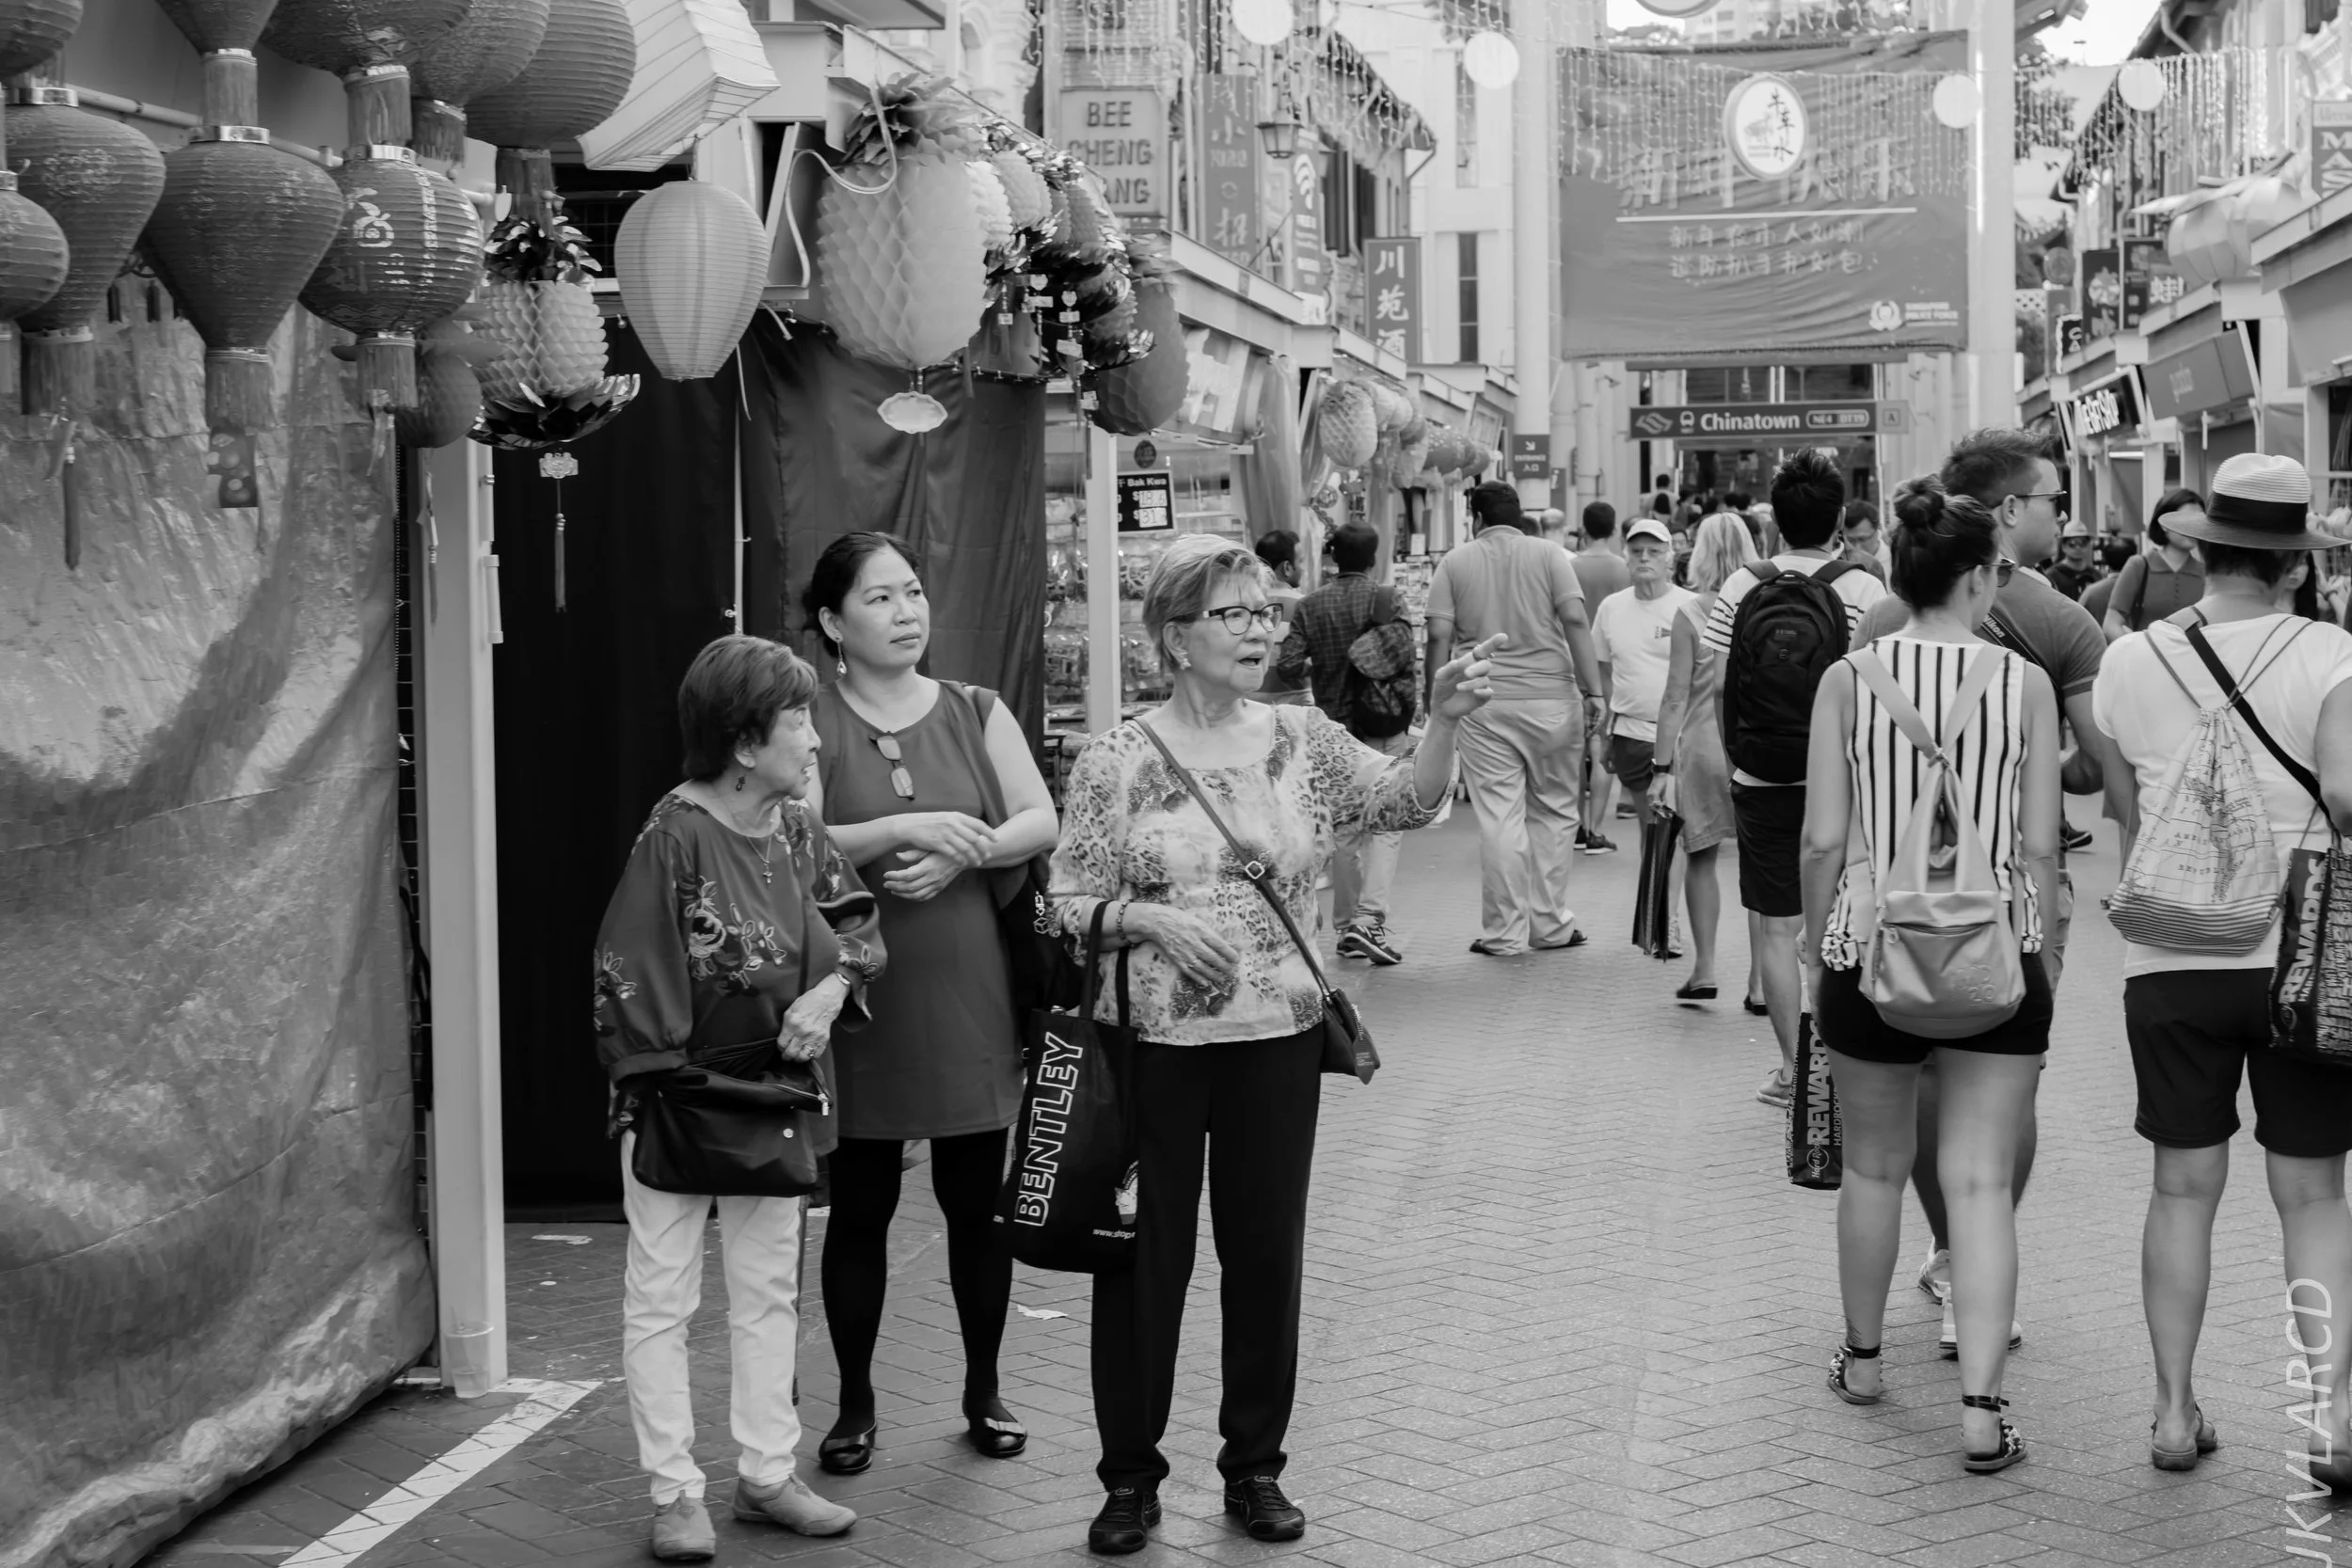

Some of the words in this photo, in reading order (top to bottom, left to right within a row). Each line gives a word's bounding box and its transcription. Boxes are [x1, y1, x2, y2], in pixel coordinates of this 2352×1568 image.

[1088, 102, 1132, 127] BEE
[1068, 139, 1153, 166] CHENG
[1700, 412, 1800, 432] Chinatown
[1812, 414, 1833, 424] NE4
[1013, 1031, 1084, 1227] BENTLEY
[1811, 1158, 1821, 1179] Hard
